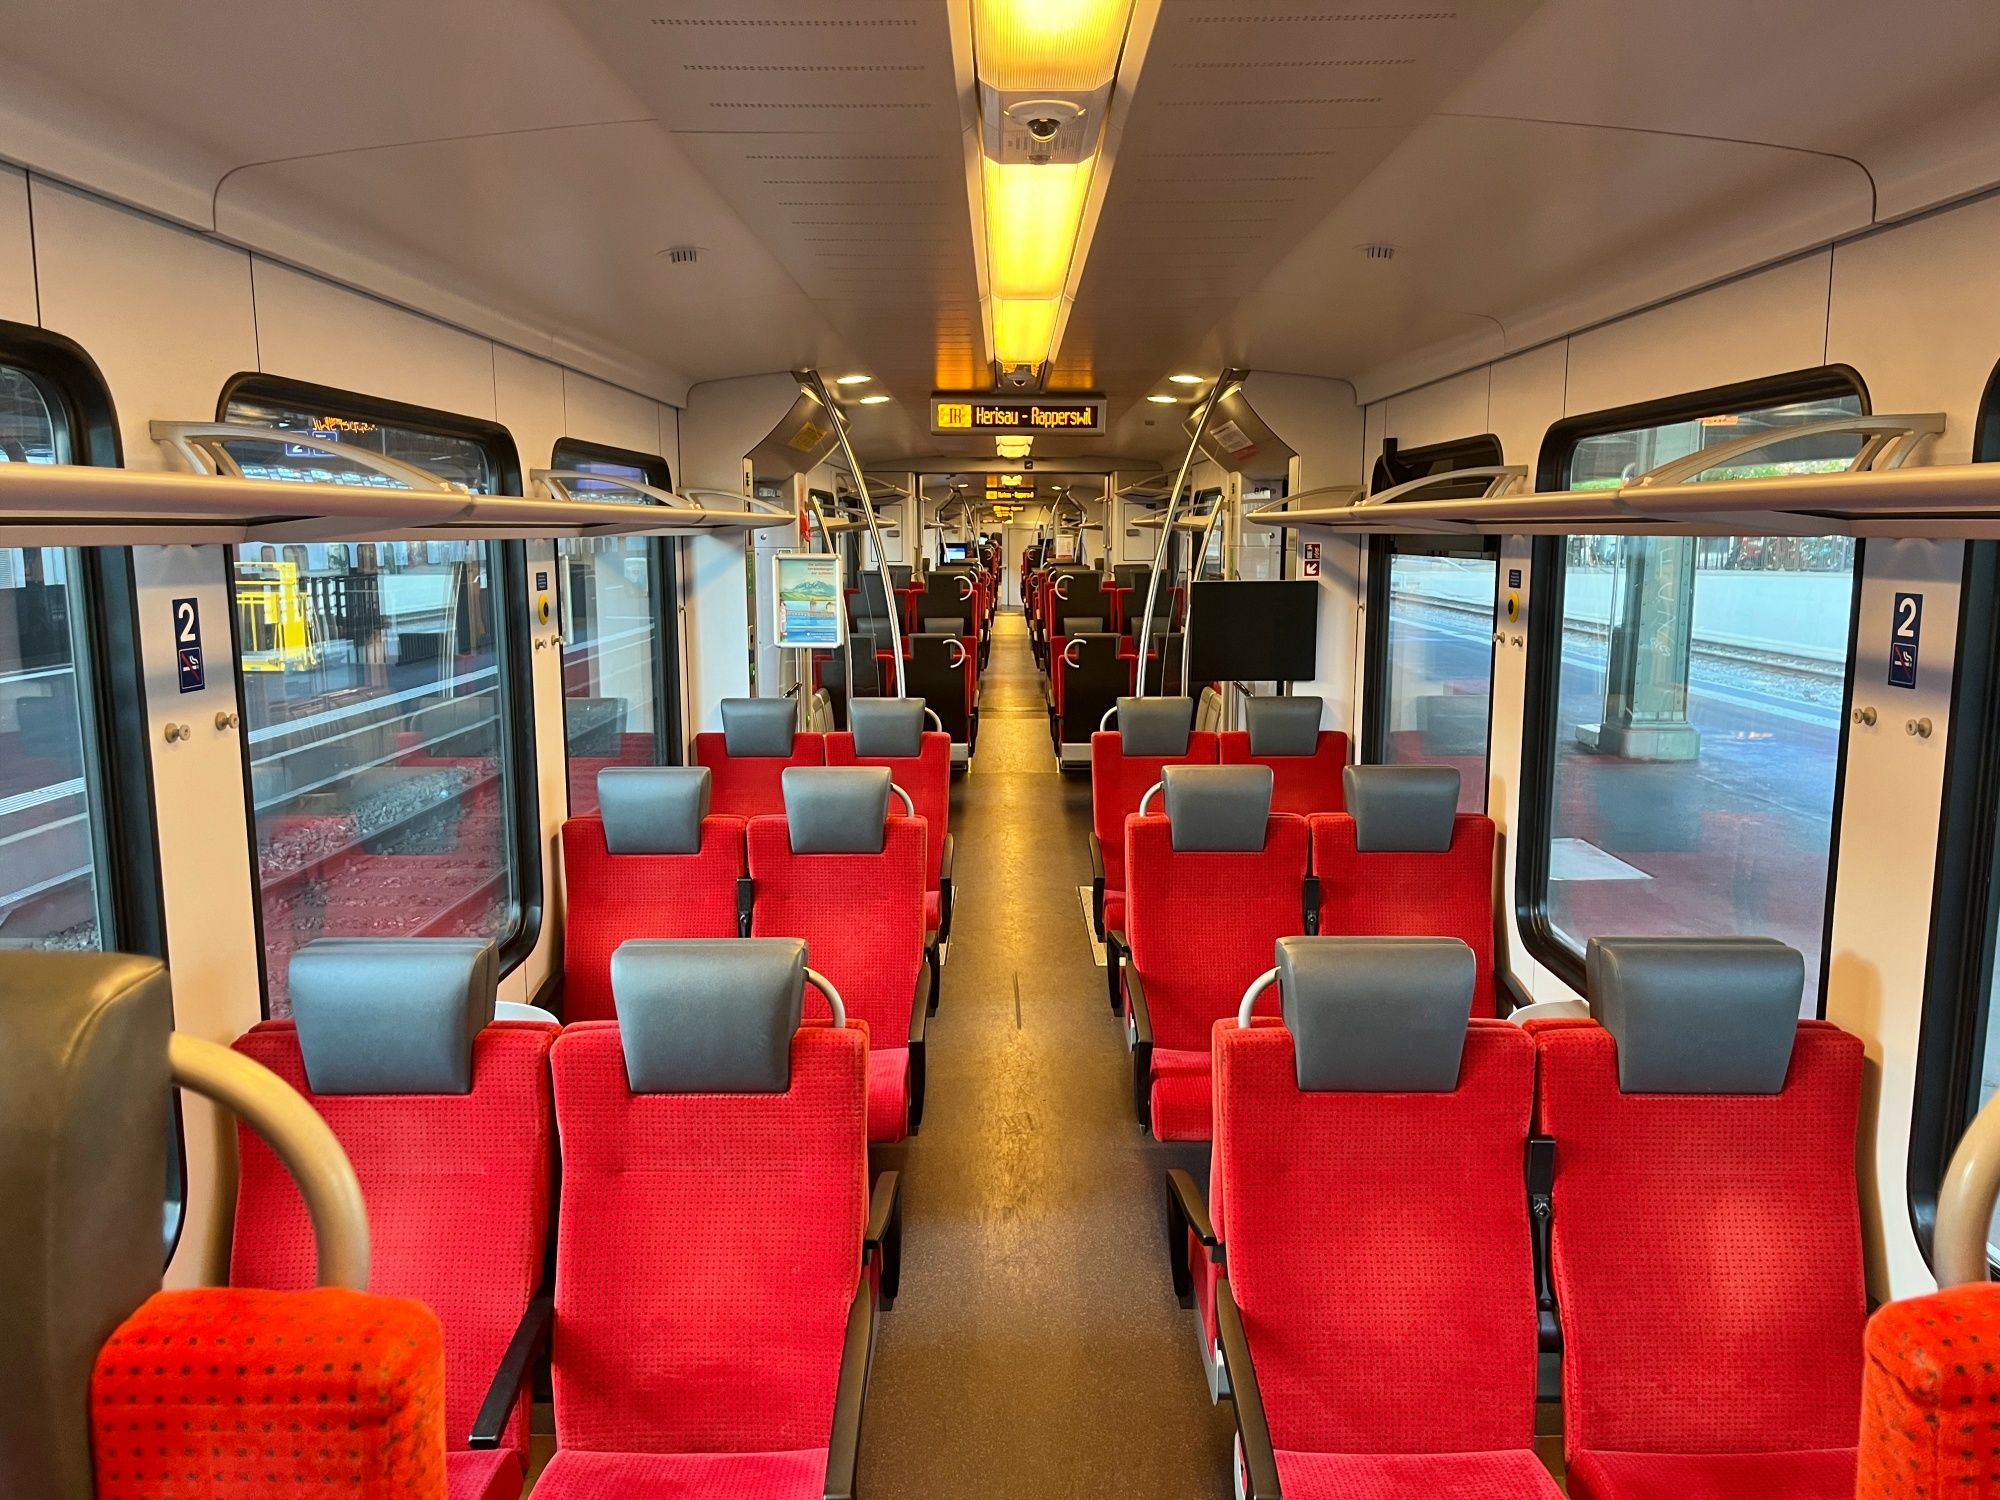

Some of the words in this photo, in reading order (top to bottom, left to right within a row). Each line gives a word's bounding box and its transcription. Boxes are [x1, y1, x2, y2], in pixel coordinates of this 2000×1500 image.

[976, 406, 1019, 425] Herisau
[1031, 406, 1092, 428] Rapperswil
[178, 602, 196, 642] 2
[1897, 597, 1917, 637] 2
